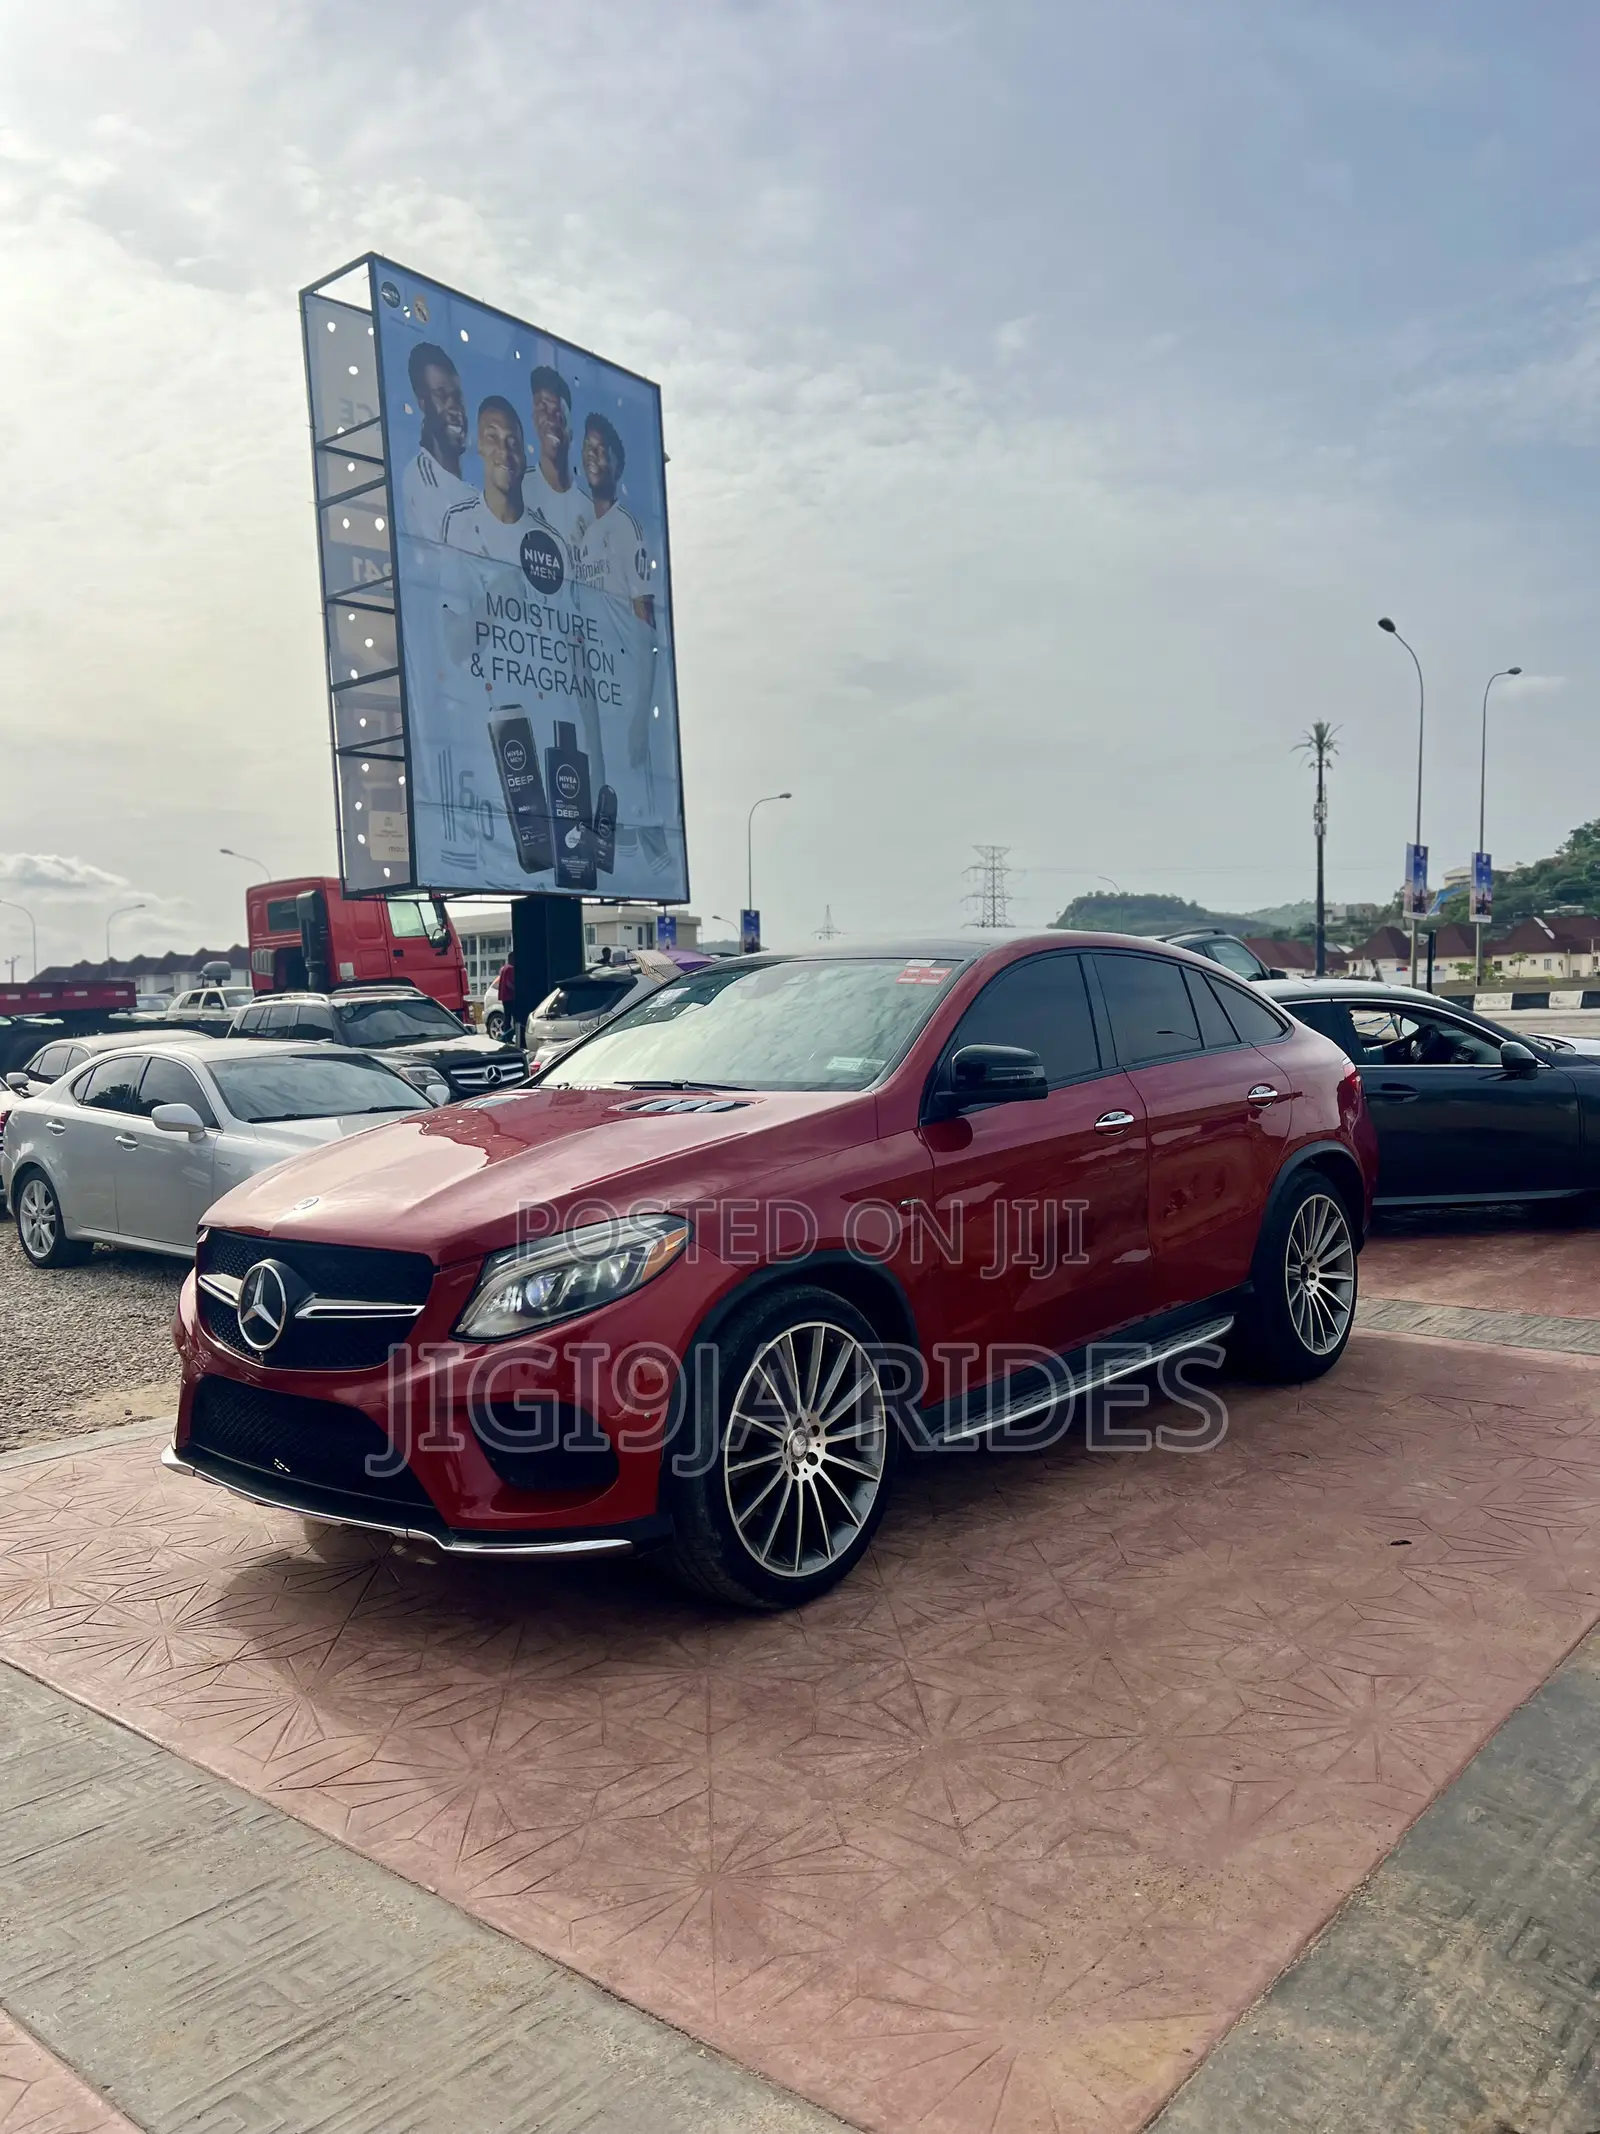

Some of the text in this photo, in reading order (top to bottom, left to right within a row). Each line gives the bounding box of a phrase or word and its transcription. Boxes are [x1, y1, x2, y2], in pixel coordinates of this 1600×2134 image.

[524, 548, 560, 569] NIVEA
[530, 564, 556, 580] MEN
[486, 592, 603, 647] MOISTURE,
[475, 621, 615, 676] PROTECTION
[470, 653, 622, 706] & FRAGRANCE
[507, 749, 523, 758] NIVEA
[508, 774, 534, 787] DEEP
[559, 776, 577, 784] NIVEA
[556, 808, 580, 818] DEEP
